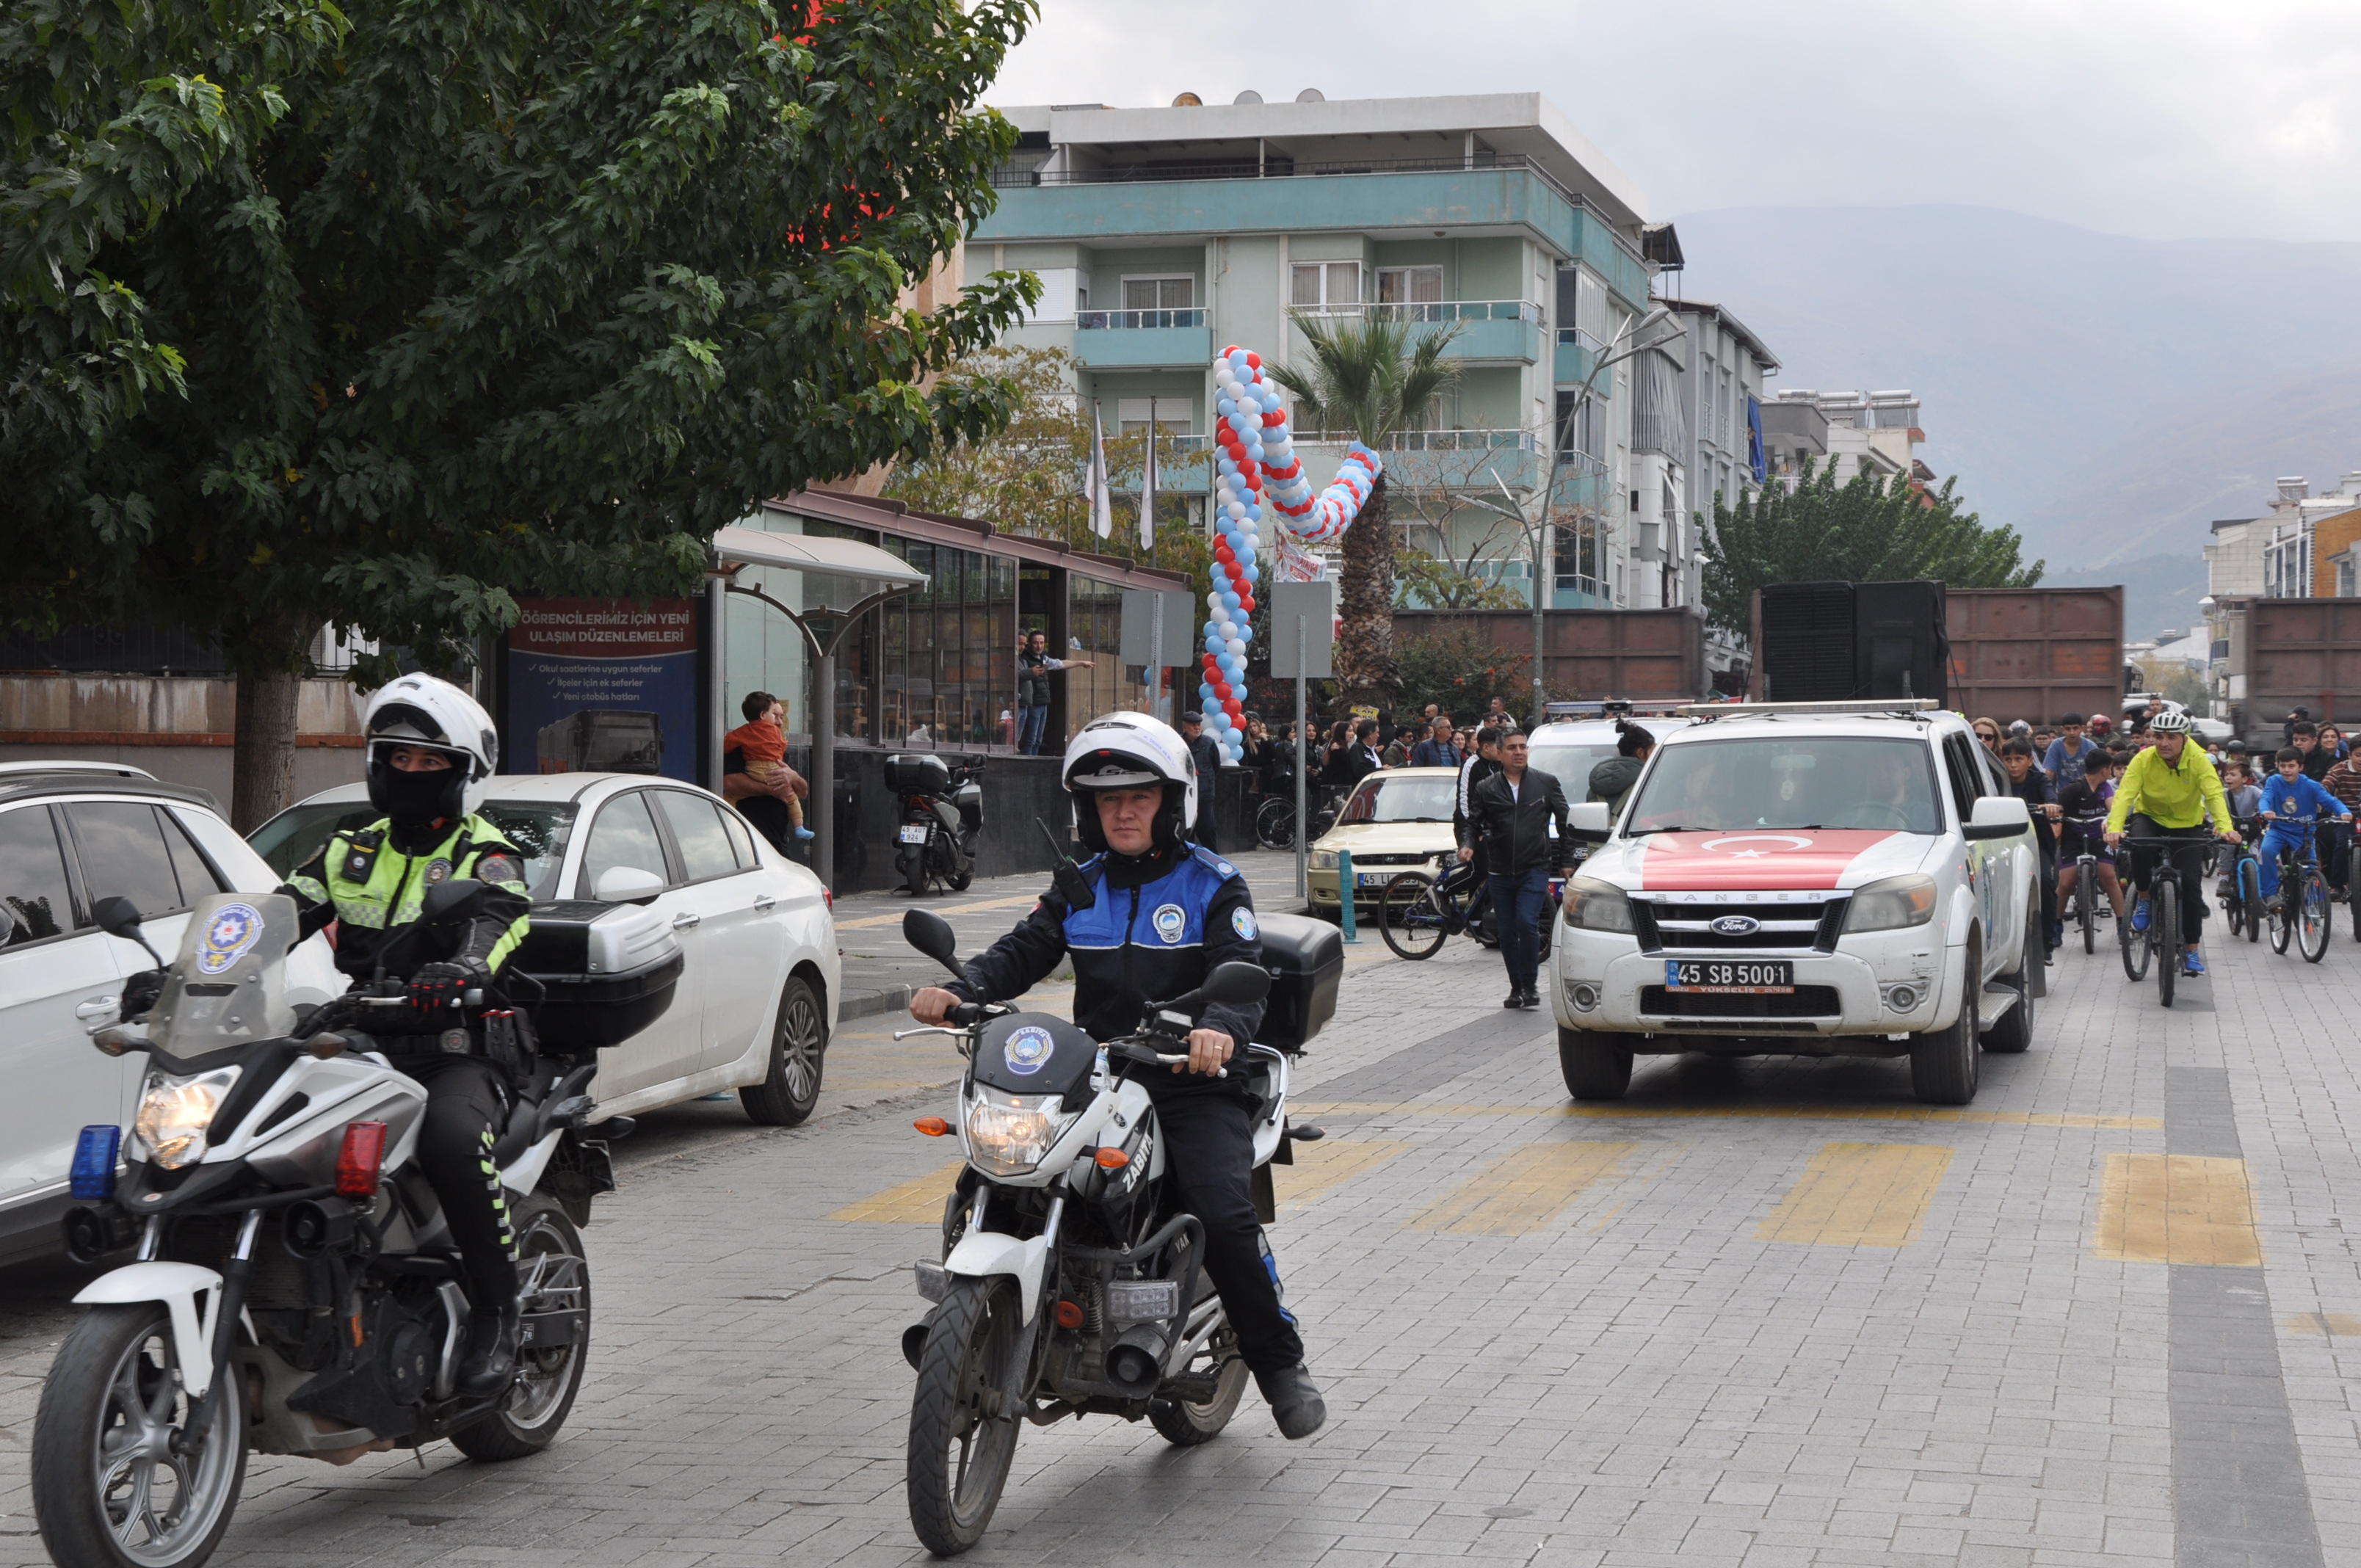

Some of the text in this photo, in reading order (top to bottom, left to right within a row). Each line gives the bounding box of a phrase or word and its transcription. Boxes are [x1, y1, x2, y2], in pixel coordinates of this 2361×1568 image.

[521, 609, 689, 627] ÖĞRENCİLERİMİZ İÇİN YENİ
[529, 628, 683, 645] ULAŞIM DÜZENLEMELERİ
[539, 664, 663, 675] Okul saatlerine uygun seferler
[557, 677, 644, 689] İlçeler için ek seferler
[563, 692, 639, 700] Yeni otobüs hatları
[1364, 874, 1375, 884] 45
[1655, 893, 1821, 901] RANGER
[1722, 919, 1748, 931] Ford
[1678, 965, 1700, 983] 45
[1709, 965, 1733, 984] SB
[1738, 965, 1785, 984] 5001
[1122, 1132, 1153, 1194] ZABITA
